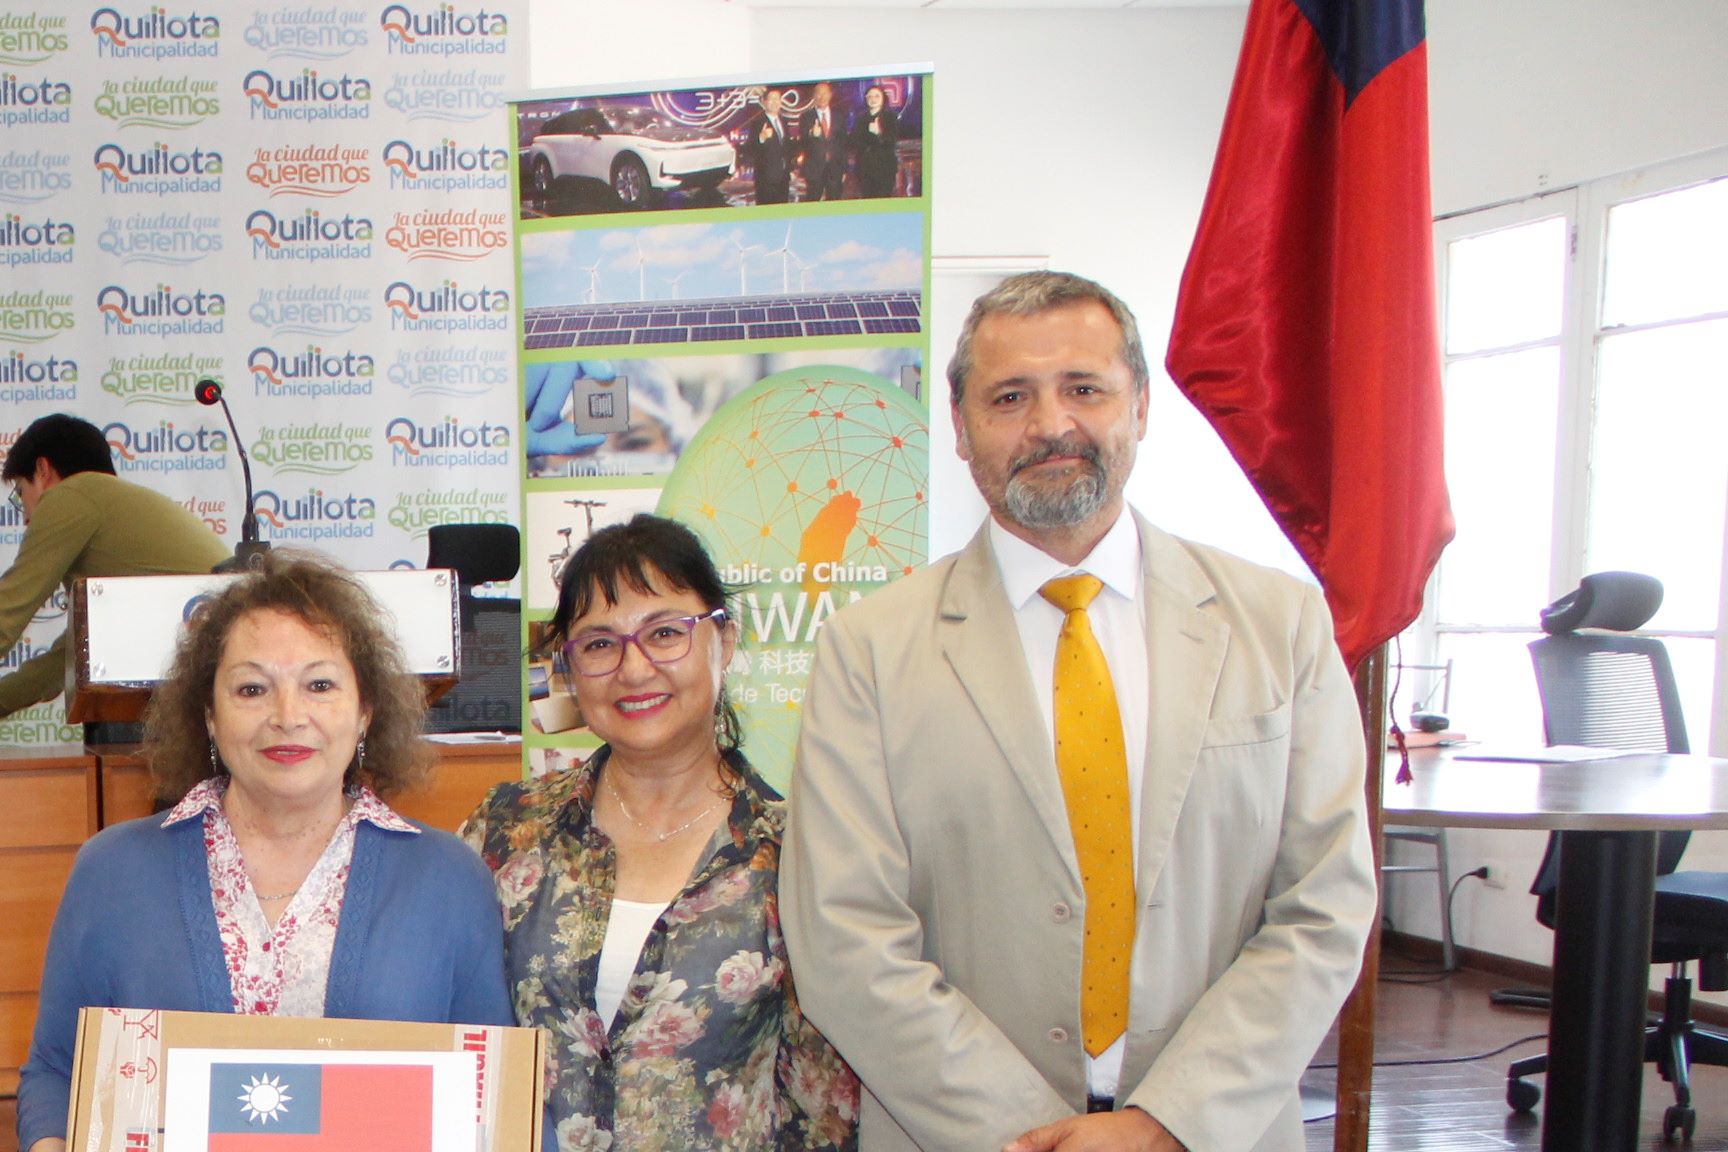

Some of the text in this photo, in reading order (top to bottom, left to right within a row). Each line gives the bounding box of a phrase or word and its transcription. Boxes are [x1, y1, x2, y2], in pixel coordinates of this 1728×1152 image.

[39, 15, 66, 32] que
[272, 7, 337, 27] ciudad
[339, 10, 365, 27] que
[98, 29, 219, 61] Municipalidad
[388, 26, 506, 58] Municipalidad
[122, 76, 188, 96] ciudad
[190, 79, 217, 96] que
[411, 69, 476, 89] ciudad
[478, 72, 504, 89] que
[251, 91, 369, 123] Municipalidad
[42, 153, 69, 170] que
[274, 144, 339, 164] ciudad
[341, 147, 367, 164] que
[101, 165, 222, 197] Municipalidad
[390, 161, 508, 193] Municipalidad
[126, 212, 191, 232] ciudad
[193, 215, 219, 232] que
[412, 209, 477, 229] ciudad
[479, 212, 505, 229] que
[253, 231, 371, 263] Municipalidad
[45, 294, 71, 311] que
[276, 284, 341, 304] ciudad
[343, 287, 369, 304] que
[105, 306, 223, 338] Municipalidad
[391, 302, 509, 334] Municipalidad
[128, 353, 193, 373] ciudad
[195, 356, 221, 373] que
[415, 346, 478, 365] ciudad
[480, 349, 506, 365] que
[255, 367, 373, 399] Municipalidad
[278, 422, 343, 442] ciudad
[345, 425, 371, 442] que
[393, 438, 509, 469] Municipalidad
[198, 499, 226, 517] que
[416, 489, 478, 508] ciudad
[480, 492, 505, 508] que
[779, 562, 807, 584] of
[812, 561, 888, 583] China
[731, 684, 758, 703] de
